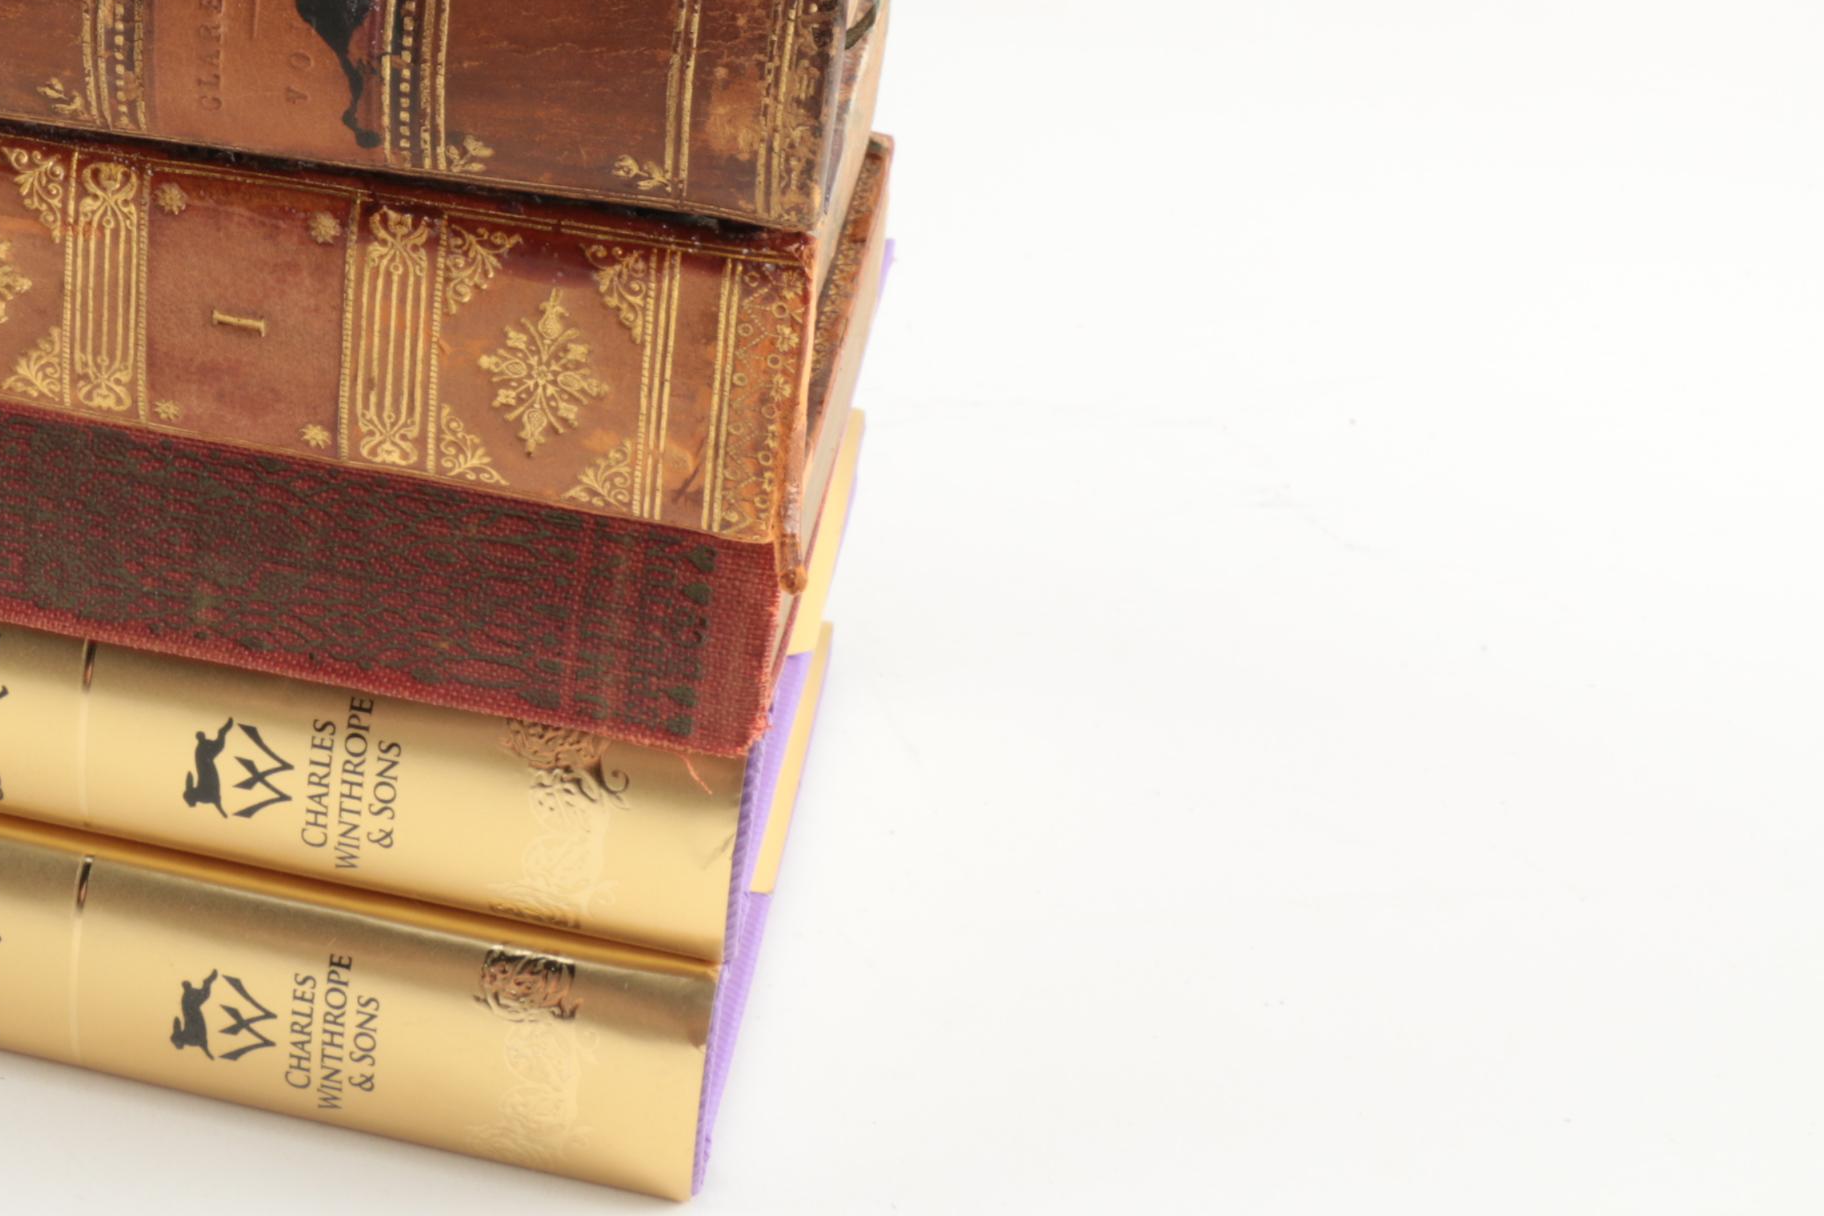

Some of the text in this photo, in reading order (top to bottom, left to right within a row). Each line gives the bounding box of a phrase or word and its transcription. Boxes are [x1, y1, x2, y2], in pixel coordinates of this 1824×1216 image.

[300, 718, 338, 849] CHARLES
[334, 696, 374, 870] WINTHROPE
[367, 739, 402, 849] & SONS
[284, 972, 318, 1090] CHARLES
[317, 952, 353, 1112] WINTHROPE
[347, 994, 382, 1093] & SONS
